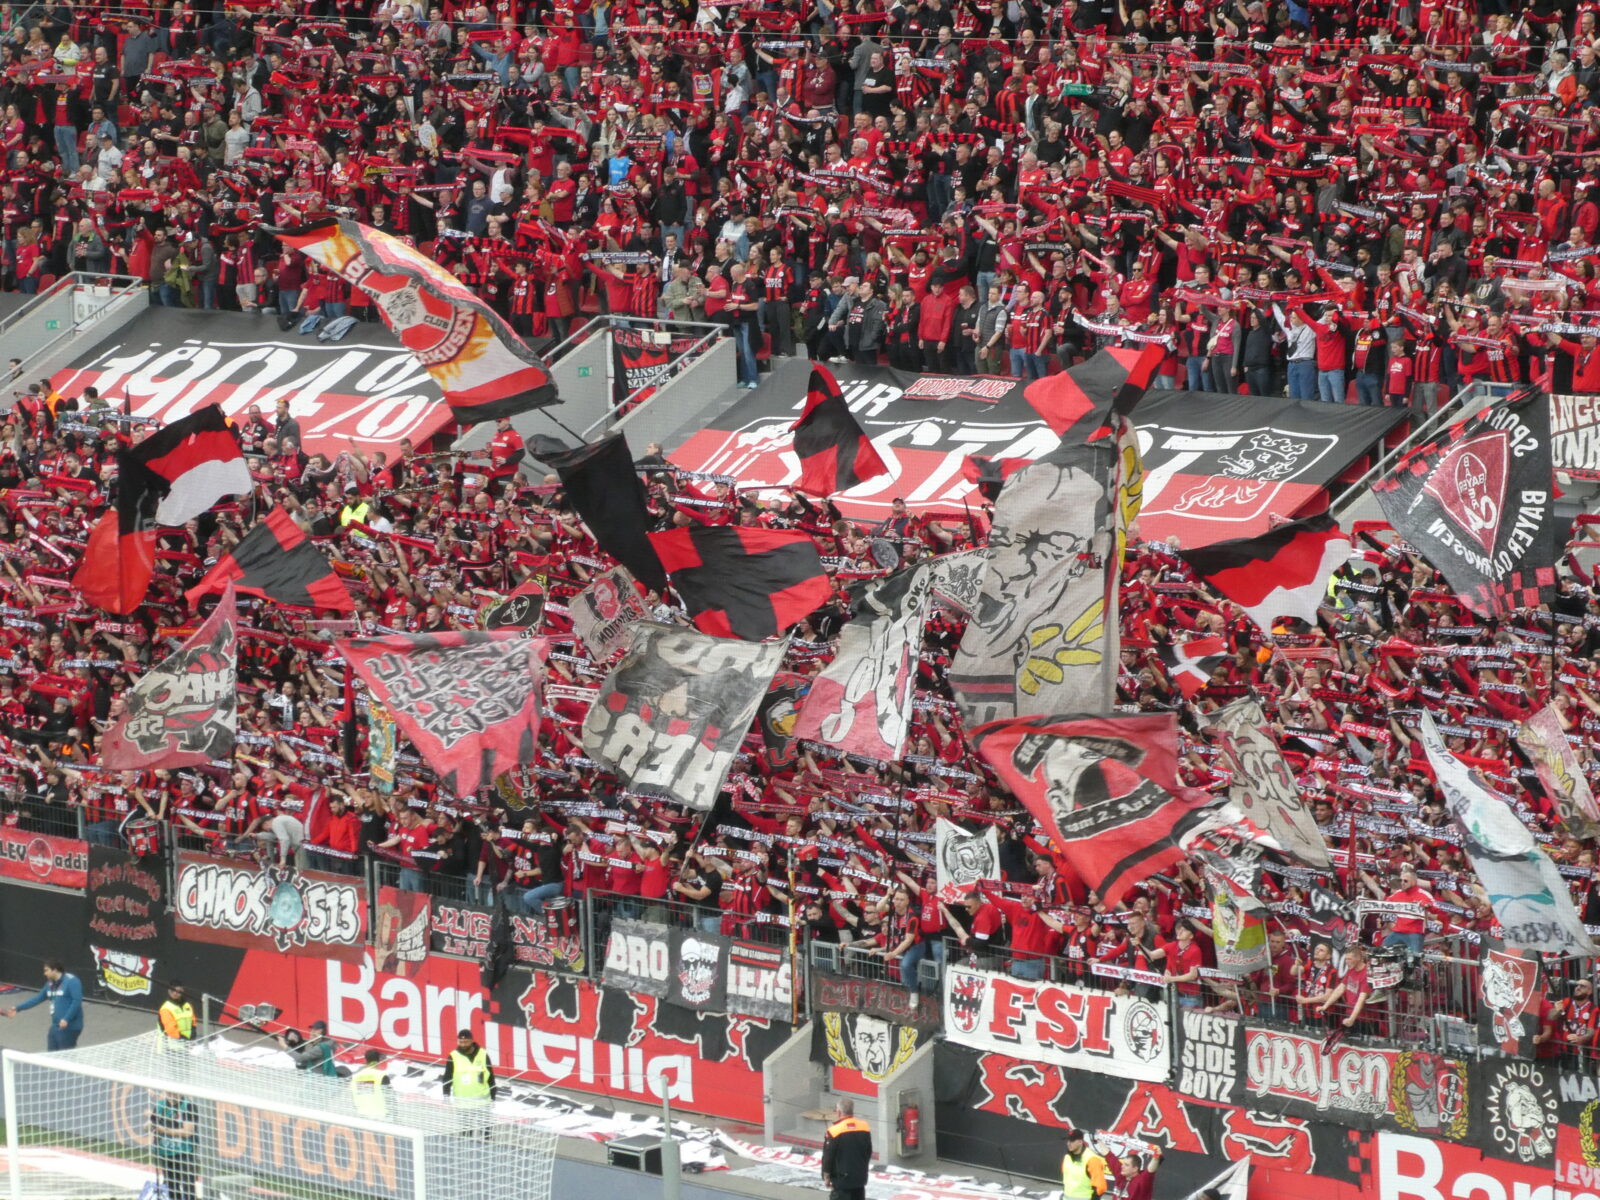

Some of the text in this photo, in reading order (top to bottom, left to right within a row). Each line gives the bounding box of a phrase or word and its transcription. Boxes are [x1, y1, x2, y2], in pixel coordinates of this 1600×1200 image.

[176, 864, 268, 936] CHAOS
[306, 883, 361, 945] 513
[605, 930, 670, 982] BRO
[325, 954, 695, 1103] Barmenia
[988, 977, 1116, 1058] FSI
[1182, 1010, 1239, 1047] WEST
[1181, 1040, 1237, 1077] SIDE
[1179, 1067, 1236, 1104] BOYZ
[1487, 1062, 1560, 1154] COMMANDO 1989
[1559, 1072, 1600, 1103] MA
